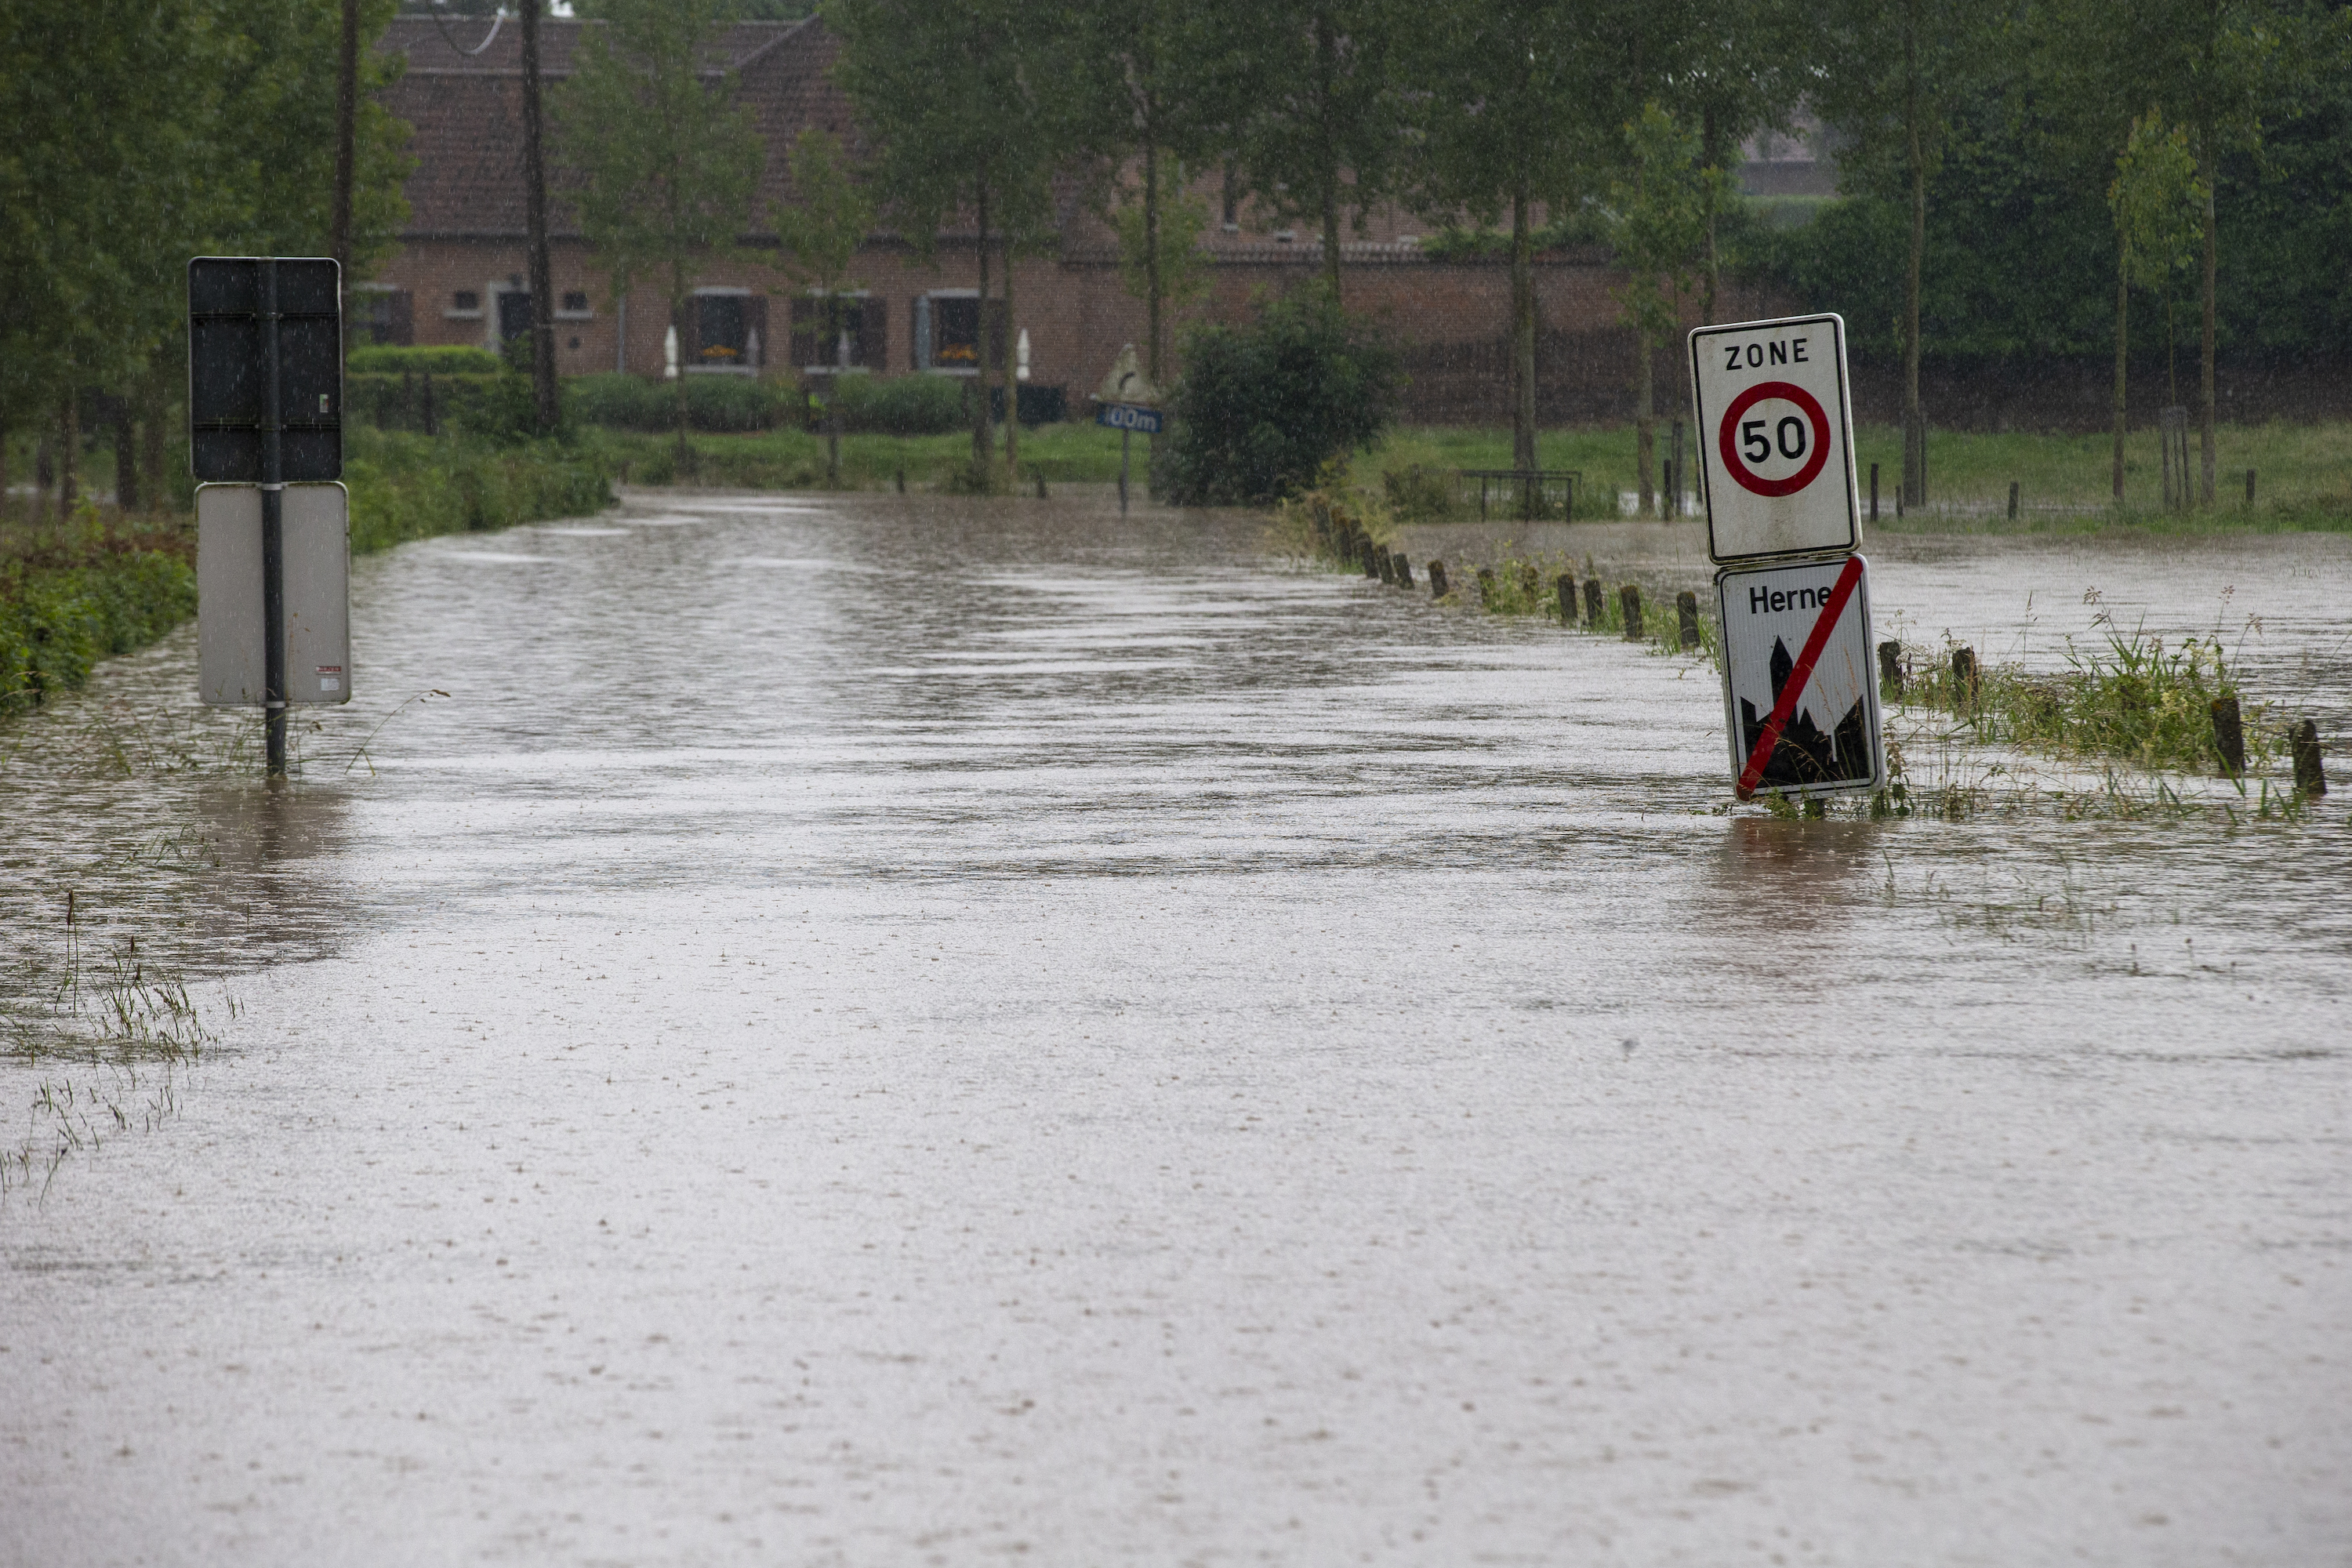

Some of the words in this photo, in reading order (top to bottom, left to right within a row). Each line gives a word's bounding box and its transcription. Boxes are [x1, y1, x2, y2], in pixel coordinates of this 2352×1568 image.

[1725, 338, 1809, 371] ZONE
[1742, 416, 1806, 463] 50
[1750, 586, 1832, 614] Herne
